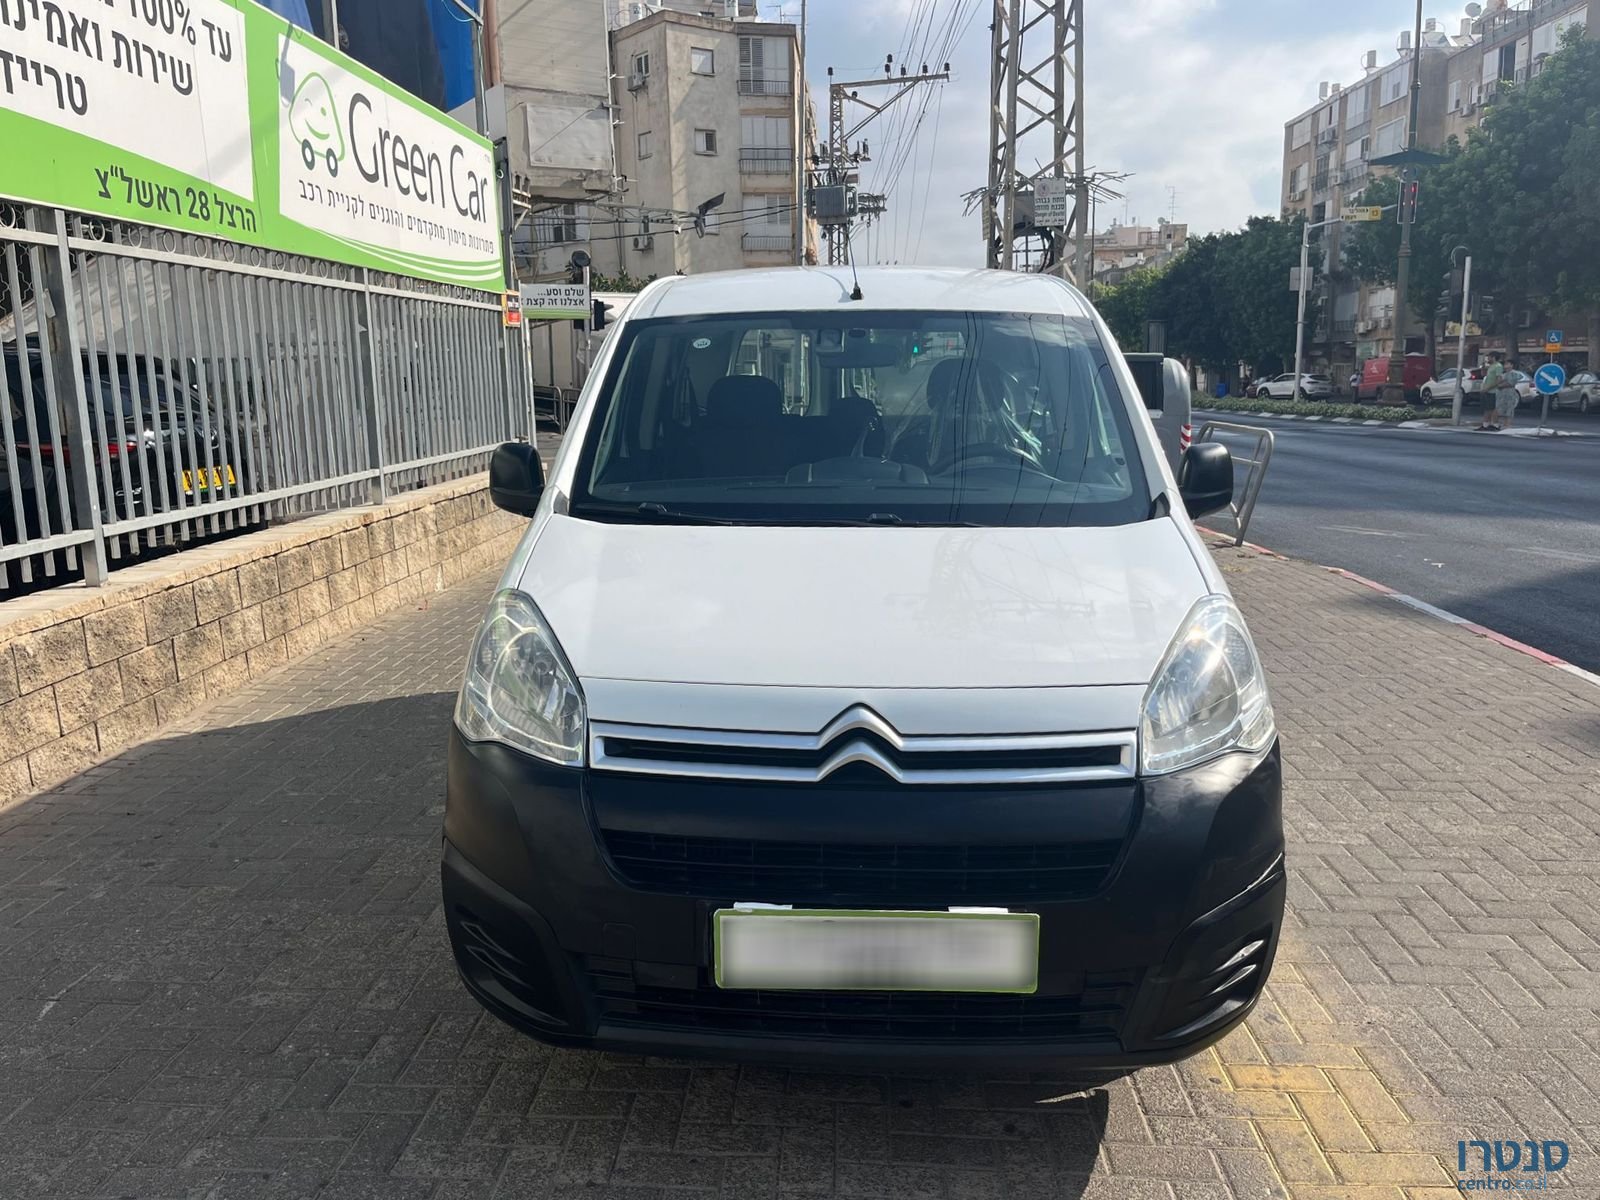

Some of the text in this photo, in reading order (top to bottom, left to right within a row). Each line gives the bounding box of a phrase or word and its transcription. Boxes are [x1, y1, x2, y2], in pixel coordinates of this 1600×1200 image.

[201, 18, 232, 62] עד
[0, 49, 88, 116] טרייד
[111, 30, 193, 95] שירות
[349, 93, 488, 223] Green Car
[185, 187, 210, 221] 28
[213, 193, 257, 233] הרצל
[299, 180, 494, 254] פתרונות מימון מתקדמים והוגנים לקניית רכב
[526, 298, 545, 307] קצת
[560, 297, 585, 306] אצלנו
[565, 288, 584, 296] שלם
